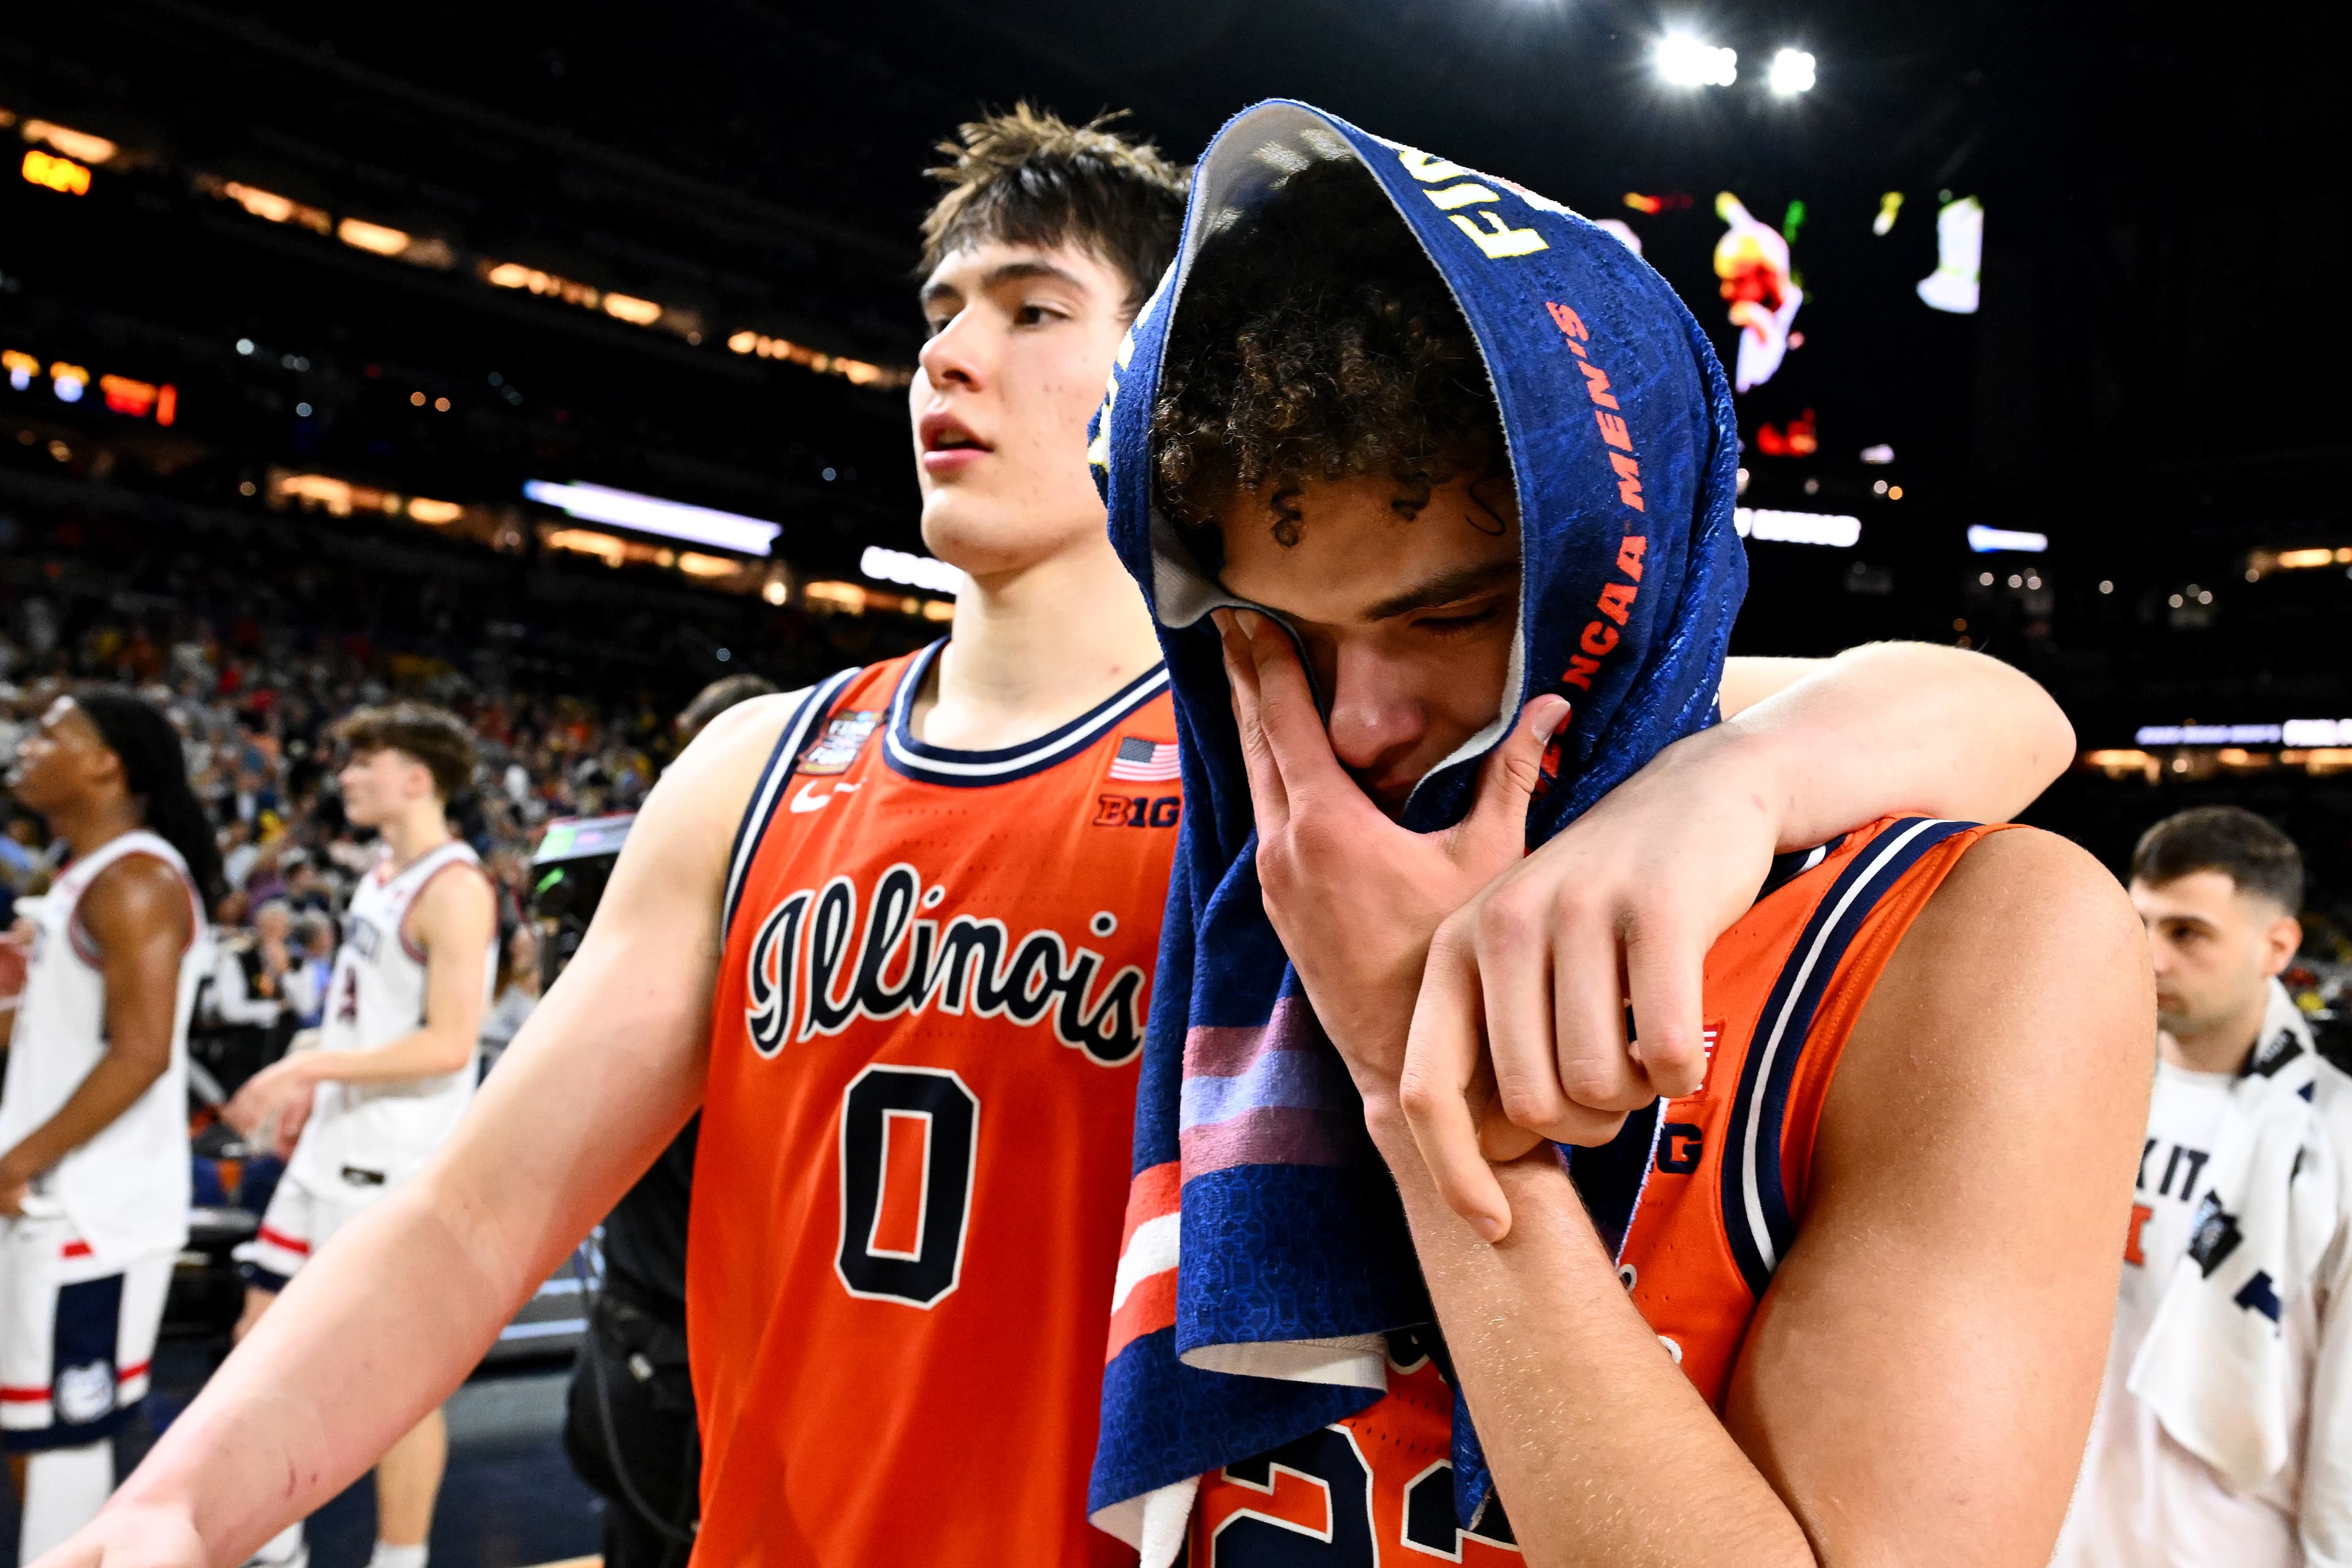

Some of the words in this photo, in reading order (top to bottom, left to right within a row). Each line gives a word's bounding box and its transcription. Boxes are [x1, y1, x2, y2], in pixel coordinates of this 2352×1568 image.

[1545, 301, 1645, 513] MEN'S
[1561, 536, 1647, 692] NCAA
[745, 862, 1145, 1067] Illinois
[834, 1063, 981, 1311] 0
[1648, 1123, 1703, 1175] G
